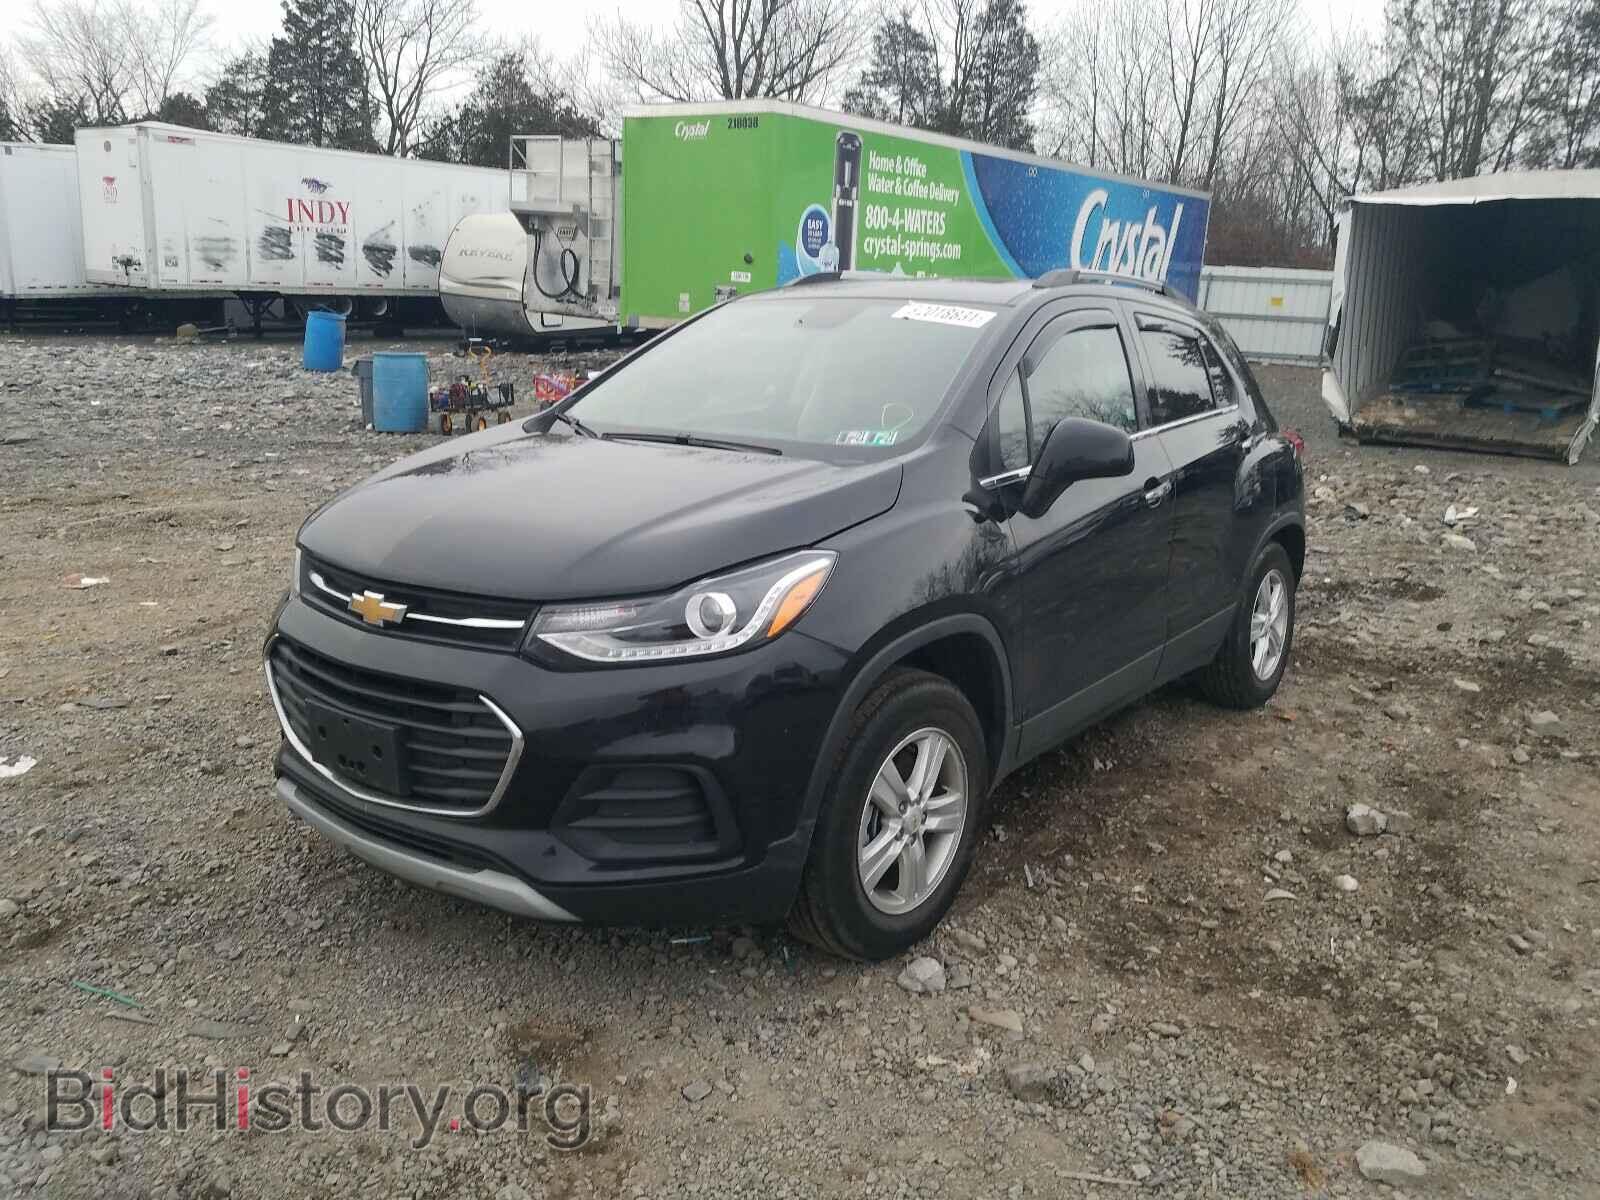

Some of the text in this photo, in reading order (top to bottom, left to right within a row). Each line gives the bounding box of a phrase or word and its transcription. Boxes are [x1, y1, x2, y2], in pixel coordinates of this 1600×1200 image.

[675, 119, 710, 141] Crystal
[868, 150, 927, 178] Home & Office
[868, 172, 960, 206] Water & Coffee Delivery
[286, 198, 350, 225] INDY
[807, 219, 824, 229] EASY
[865, 204, 946, 235] 800-4-WATERS
[863, 233, 961, 262] crystal-springs.com
[1071, 190, 1184, 281] Crystal
